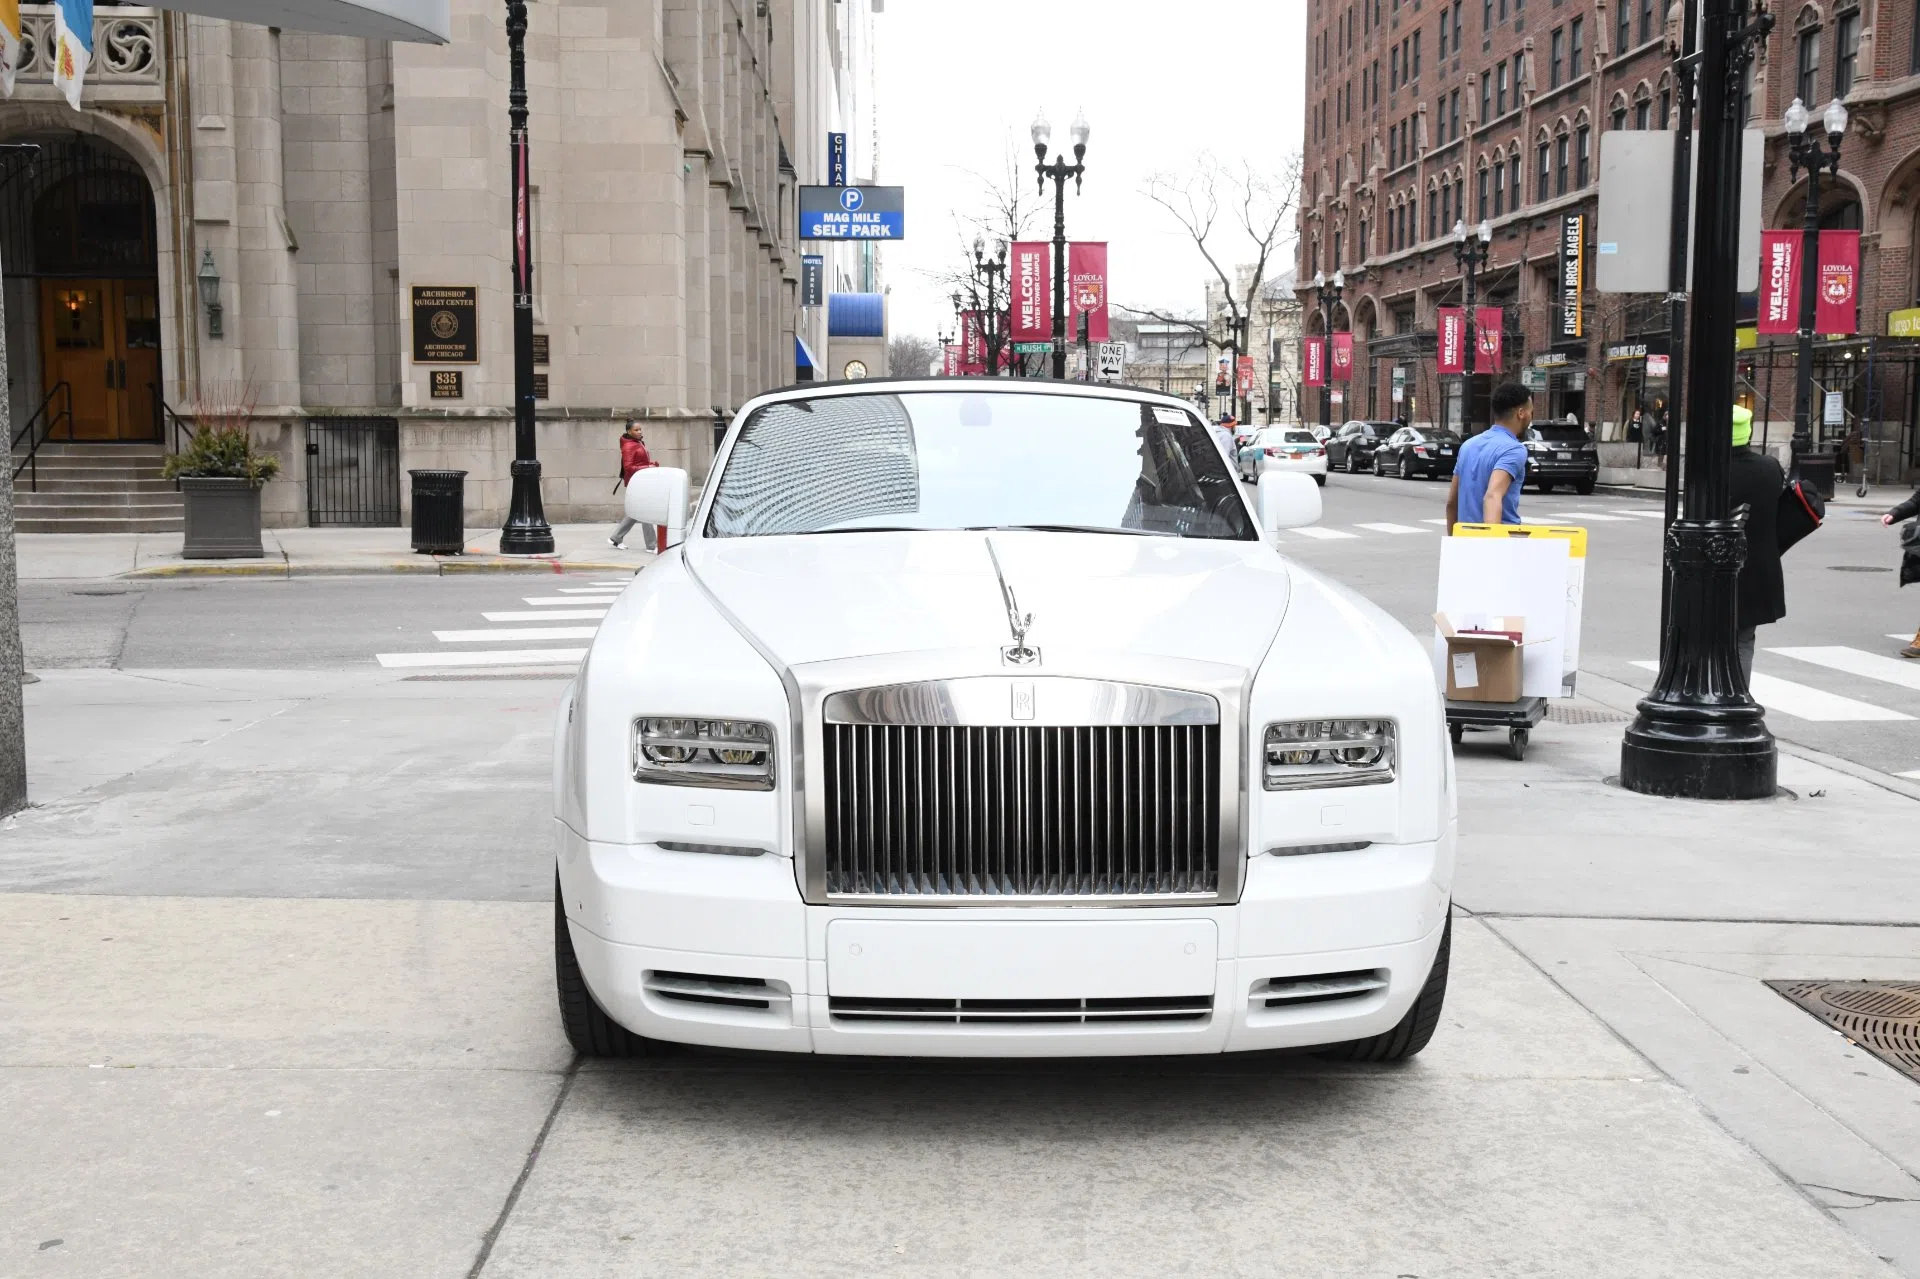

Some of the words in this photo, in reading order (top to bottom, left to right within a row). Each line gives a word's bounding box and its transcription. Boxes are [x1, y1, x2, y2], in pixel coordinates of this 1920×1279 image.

[823, 212, 850, 223] MAG
[852, 212, 881, 223] MILE
[812, 224, 849, 237] SELF
[851, 224, 892, 237] PARK
[1566, 216, 1580, 256] BAGELS
[1784, 243, 1792, 272] CAMPUS
[1822, 264, 1852, 272] LOYOLA
[1073, 273, 1103, 282] LOYOLA
[1769, 242, 1785, 321] WELCOME
[1021, 252, 1034, 329] WELCOME
[1783, 272, 1791, 298] TOWER
[421, 290, 467, 298] ARCHBISHOP
[414, 299, 445, 307] QUIGLEY
[1781, 298, 1790, 321] WATER
[1563, 289, 1577, 335] EINSTEIN
[1444, 315, 1454, 366] WELCOME
[1022, 343, 1042, 352] RUSH
[1101, 345, 1122, 356] ONE
[1100, 355, 1121, 366] WAY
[436, 372, 457, 385] 835
